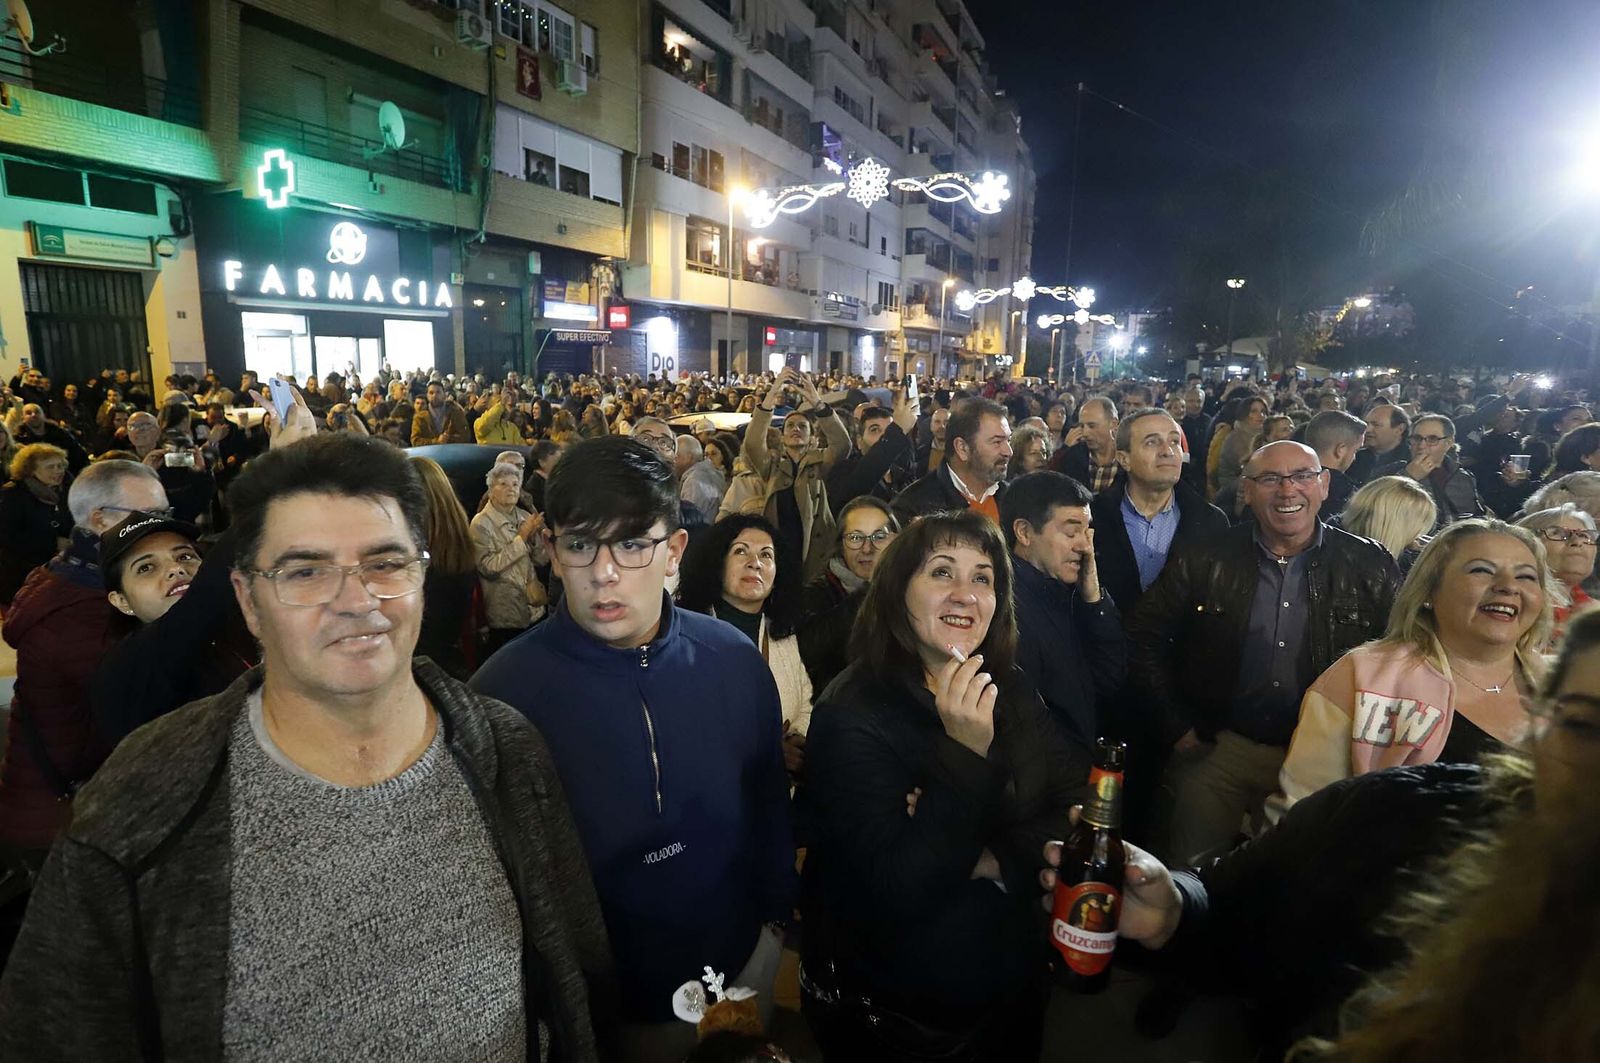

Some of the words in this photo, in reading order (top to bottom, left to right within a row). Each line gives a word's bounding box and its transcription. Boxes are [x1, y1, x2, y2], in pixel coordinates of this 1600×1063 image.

[224, 260, 453, 308] FARMACIA
[556, 332, 579, 341] SUPER
[580, 333, 609, 342] EFECTIVO
[652, 352, 675, 371] Dia
[1352, 690, 1444, 747] NEW
